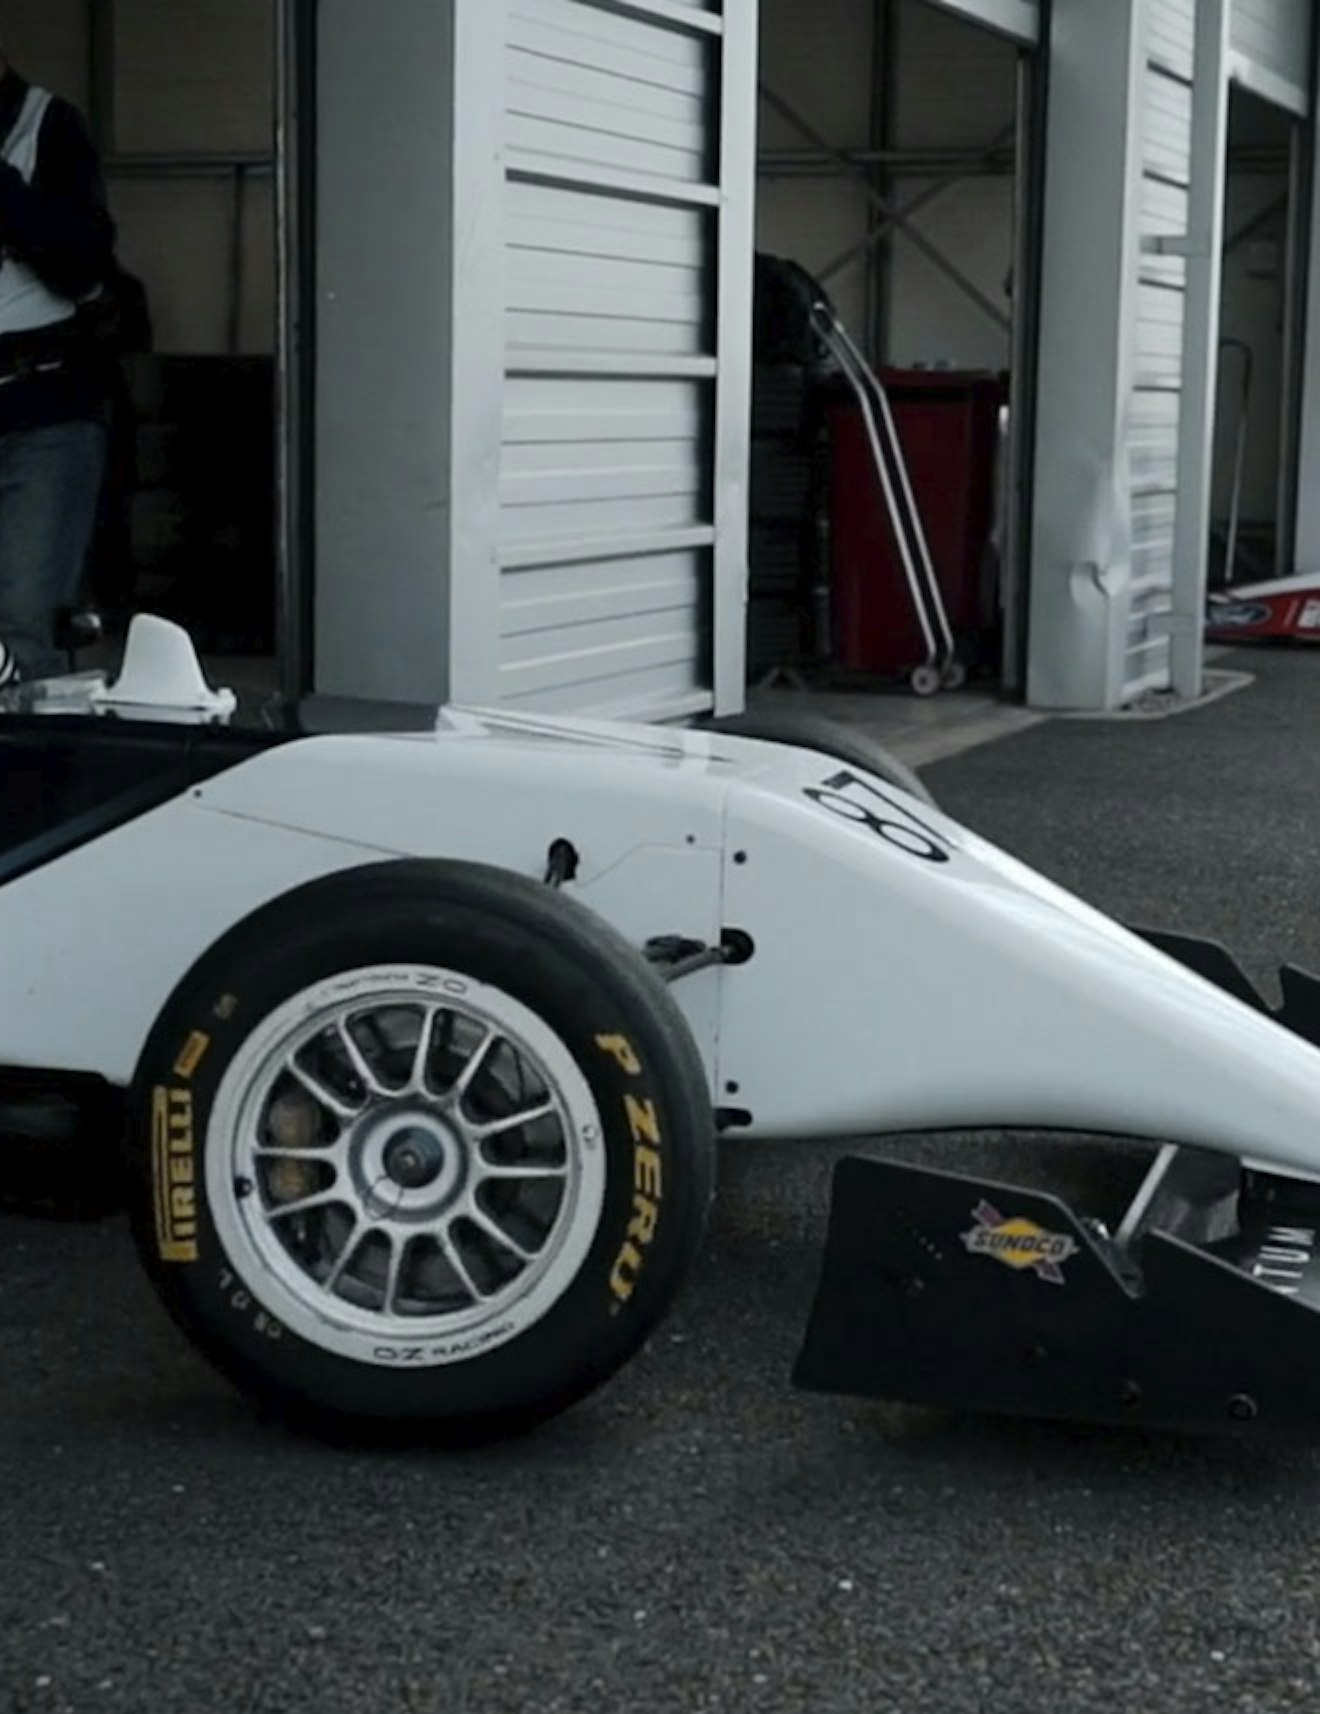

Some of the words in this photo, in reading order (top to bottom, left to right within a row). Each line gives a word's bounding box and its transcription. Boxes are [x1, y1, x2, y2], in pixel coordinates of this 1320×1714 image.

[802, 769, 957, 863] 87
[593, 1032, 642, 1078] P
[152, 1084, 199, 1262] PIRELLI
[608, 1093, 663, 1303] ZERO
[974, 1231, 1065, 1256] SUNOCO
[1252, 1225, 1316, 1294] TUM
